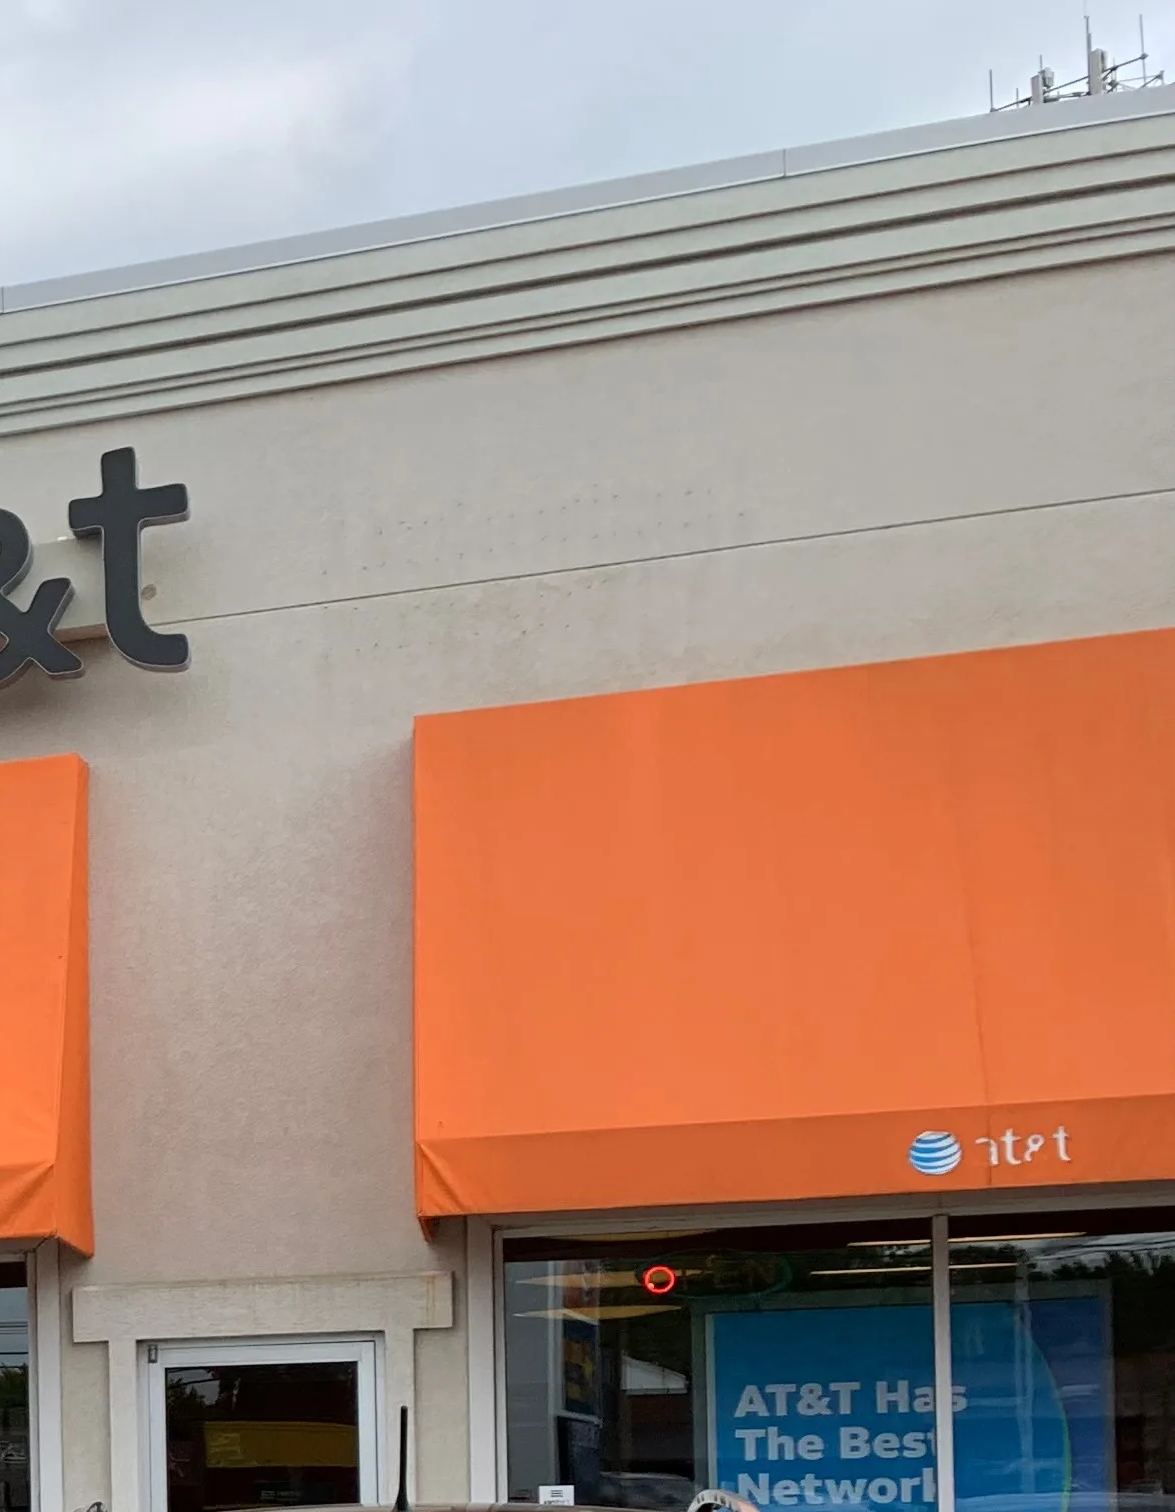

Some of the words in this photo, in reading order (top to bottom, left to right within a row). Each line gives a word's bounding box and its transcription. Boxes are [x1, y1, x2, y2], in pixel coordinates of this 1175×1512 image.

[734, 1381, 860, 1418] AT&T
[876, 1380, 967, 1413] Has
[735, 1426, 824, 1461] The
